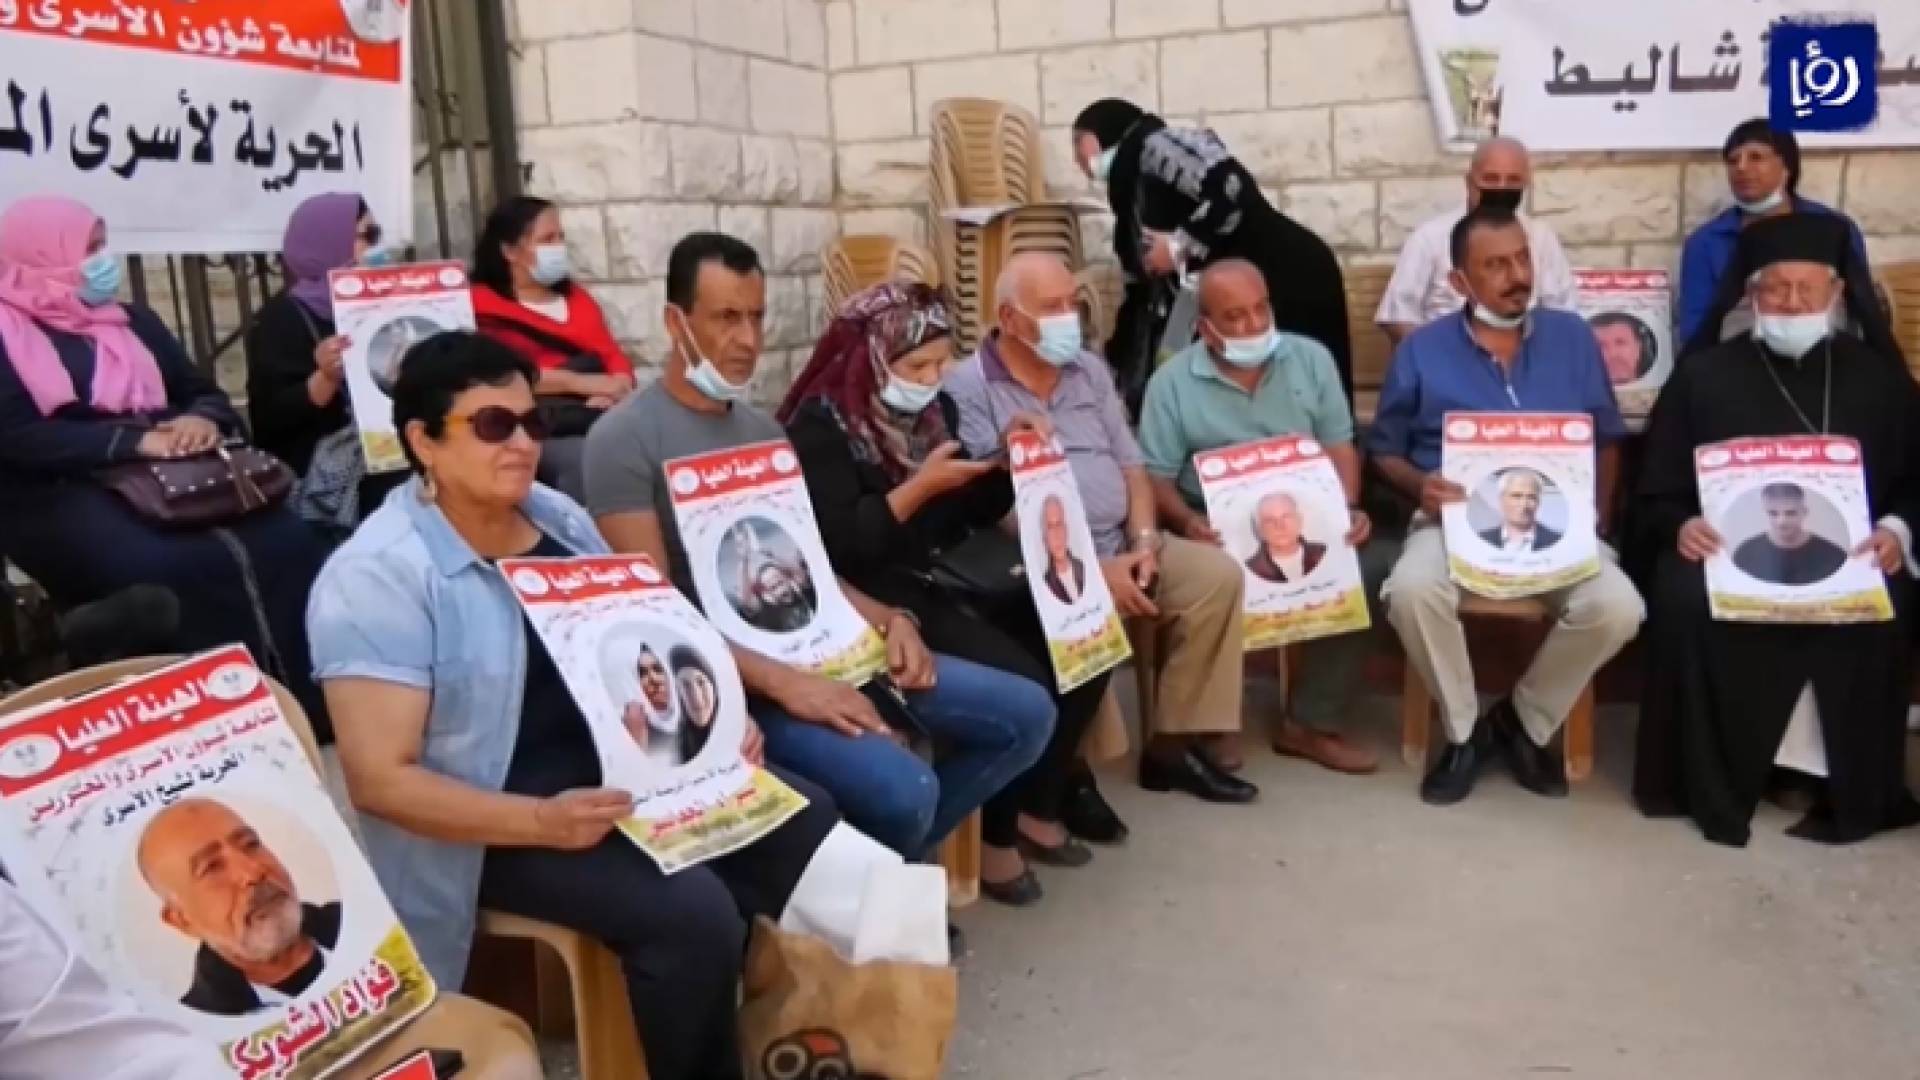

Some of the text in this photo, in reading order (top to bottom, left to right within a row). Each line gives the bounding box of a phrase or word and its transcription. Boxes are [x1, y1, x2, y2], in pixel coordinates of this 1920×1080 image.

[177, 15, 266, 56] شؤون
[1543, 29, 1742, 112] شاليط
[229, 97, 365, 192] الحرية
[56, 677, 209, 755] الهيئة العليا
[231, 956, 400, 1080] فؤاد الشوبك
